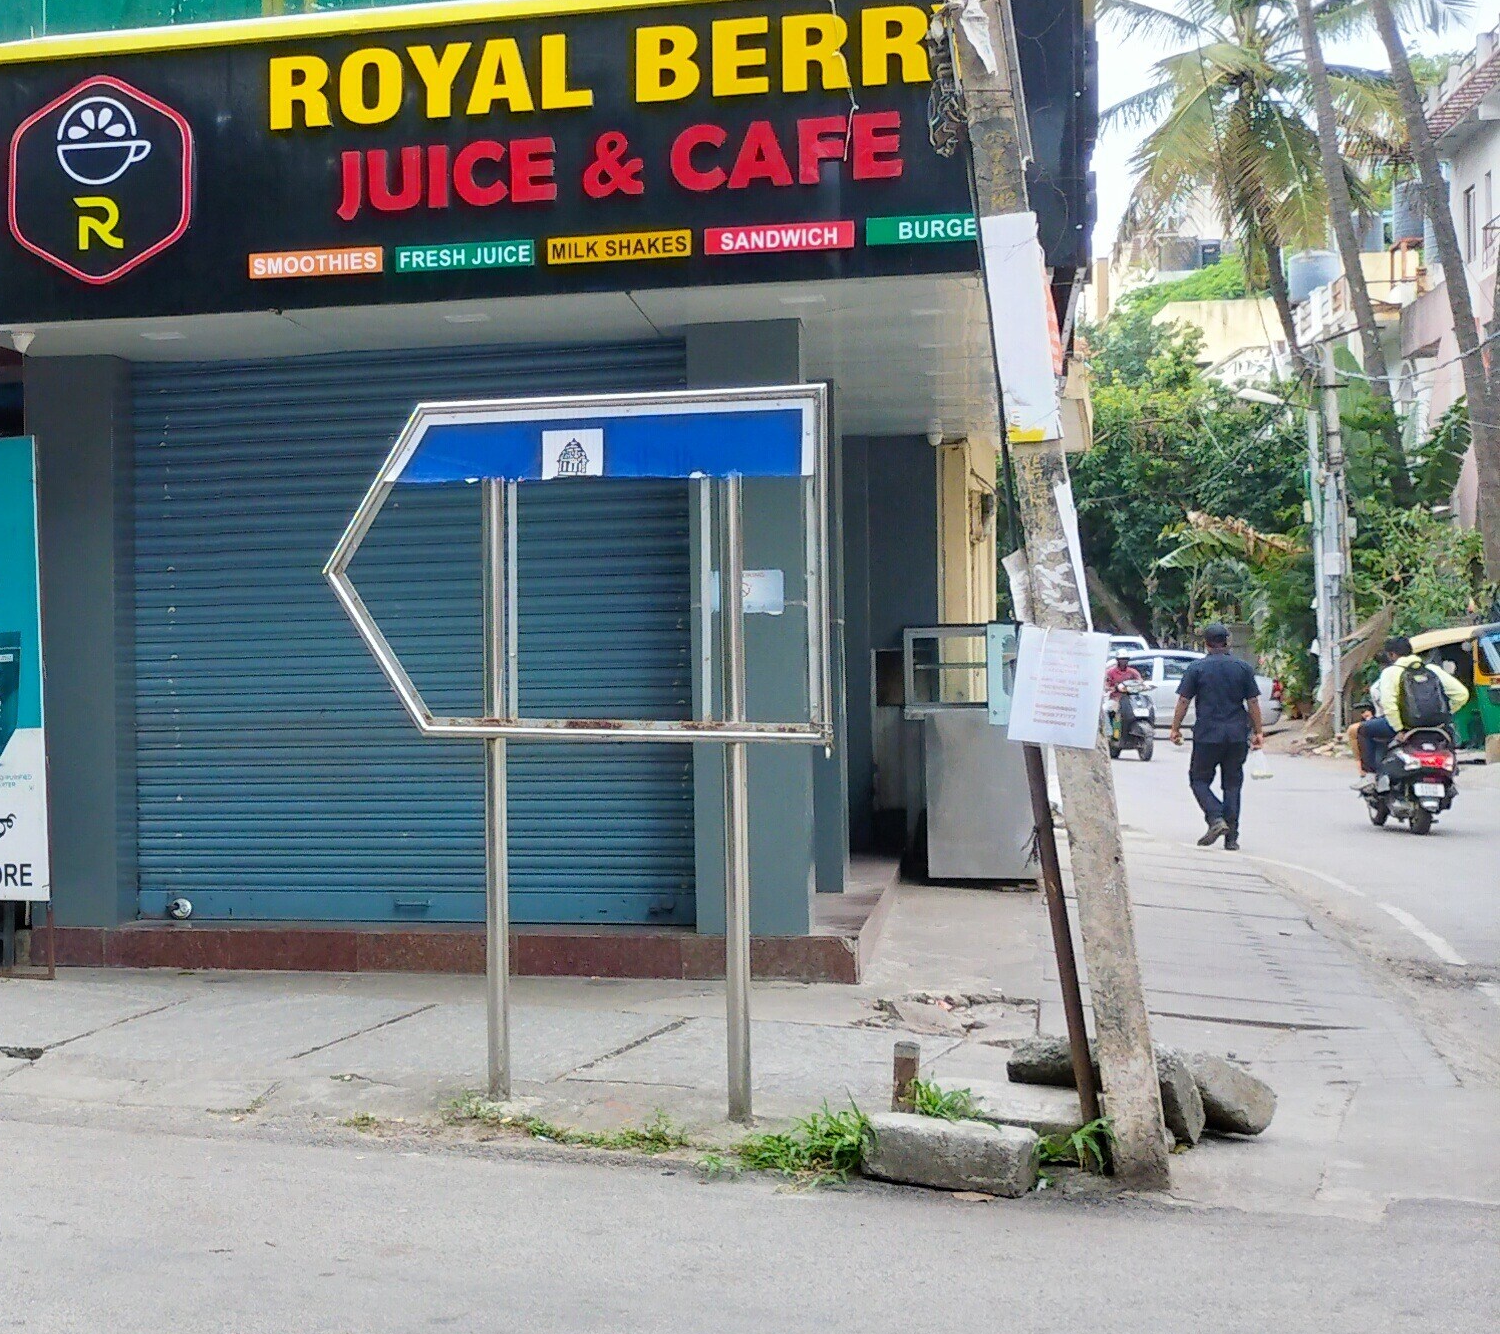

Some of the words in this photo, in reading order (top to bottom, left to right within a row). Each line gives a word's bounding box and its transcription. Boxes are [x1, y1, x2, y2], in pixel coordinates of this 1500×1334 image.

[270, 34, 594, 131] ROYAL
[336, 136, 558, 221] JUICE
[582, 130, 645, 199] &
[670, 110, 904, 191] CAFE
[73, 196, 125, 251] R
[898, 218, 977, 242] BURGE
[551, 241, 599, 261] MILK
[605, 235, 688, 257] SHAKES
[720, 227, 839, 251] SANDWICH
[253, 251, 378, 276] SMOOTHIES
[399, 248, 467, 270] FRESH
[471, 244, 532, 266] JUICE
